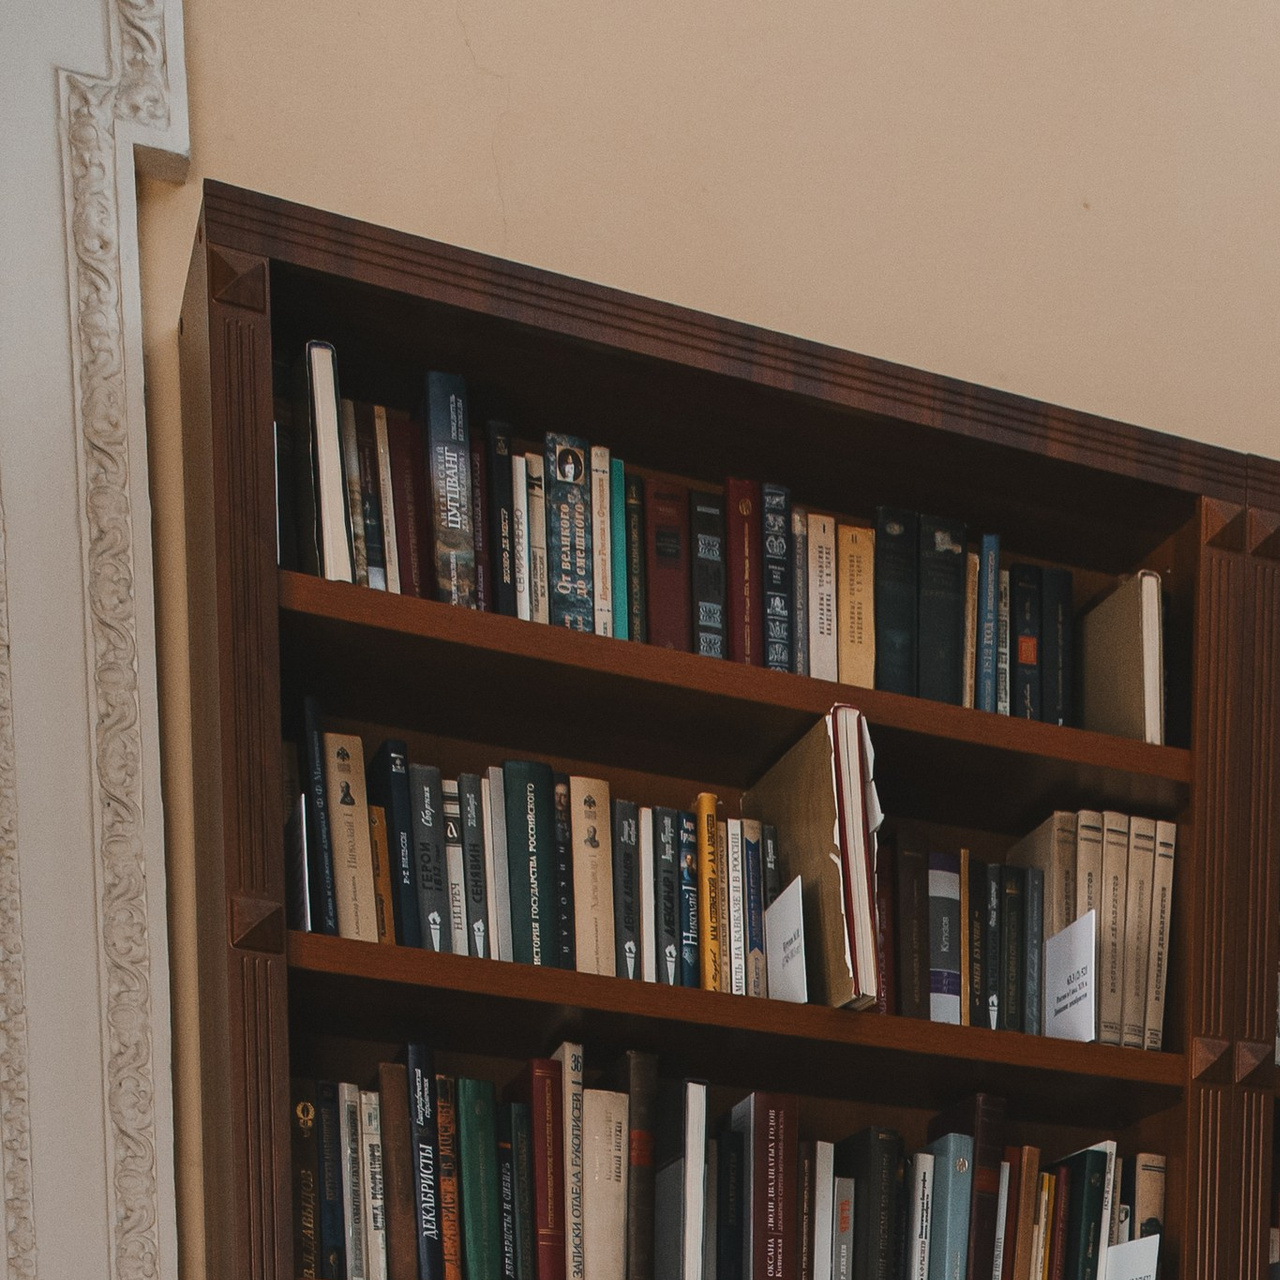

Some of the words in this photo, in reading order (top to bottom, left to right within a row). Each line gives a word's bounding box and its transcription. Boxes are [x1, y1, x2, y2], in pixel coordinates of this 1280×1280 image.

[445, 446, 461, 530] ЦУГЦВАНГ
[559, 503, 570, 570] великого
[573, 502, 585, 576] смешного
[557, 574, 571, 594] От
[575, 580, 588, 598] до
[983, 620, 994, 646] ГОД
[983, 647, 993, 675] 1812
[421, 785, 433, 828] Сборник
[526, 782, 537, 853] РОССИЙСКОГО
[344, 818, 357, 870] Николай
[420, 842, 433, 891] ГЕРОИ
[730, 832, 739, 872] РОССИИ
[468, 843, 484, 904] СЕНЯВИН
[528, 856, 540, 919] ГОСУДАРСТВА
[662, 876, 675, 939] АЛЕКСАНДР
[682, 892, 698, 946] Николай
[731, 895, 742, 942] КАВКАЗЕ
[1111, 874, 1120, 939] ДЕКАБРИСТОВ
[531, 922, 541, 965] ИСТОРИЯ
[1110, 940, 1119, 994] ВОССТАНИЕ
[415, 1068, 424, 1126] Биографический
[438, 1098, 454, 1157] МОСКВЕ
[569, 1092, 581, 1168] РУКОПИСЕЙ
[768, 1109, 776, 1140] ГОДОВ
[419, 1142, 438, 1240] ДЕКАБРИСТЫ
[501, 1162, 511, 1201] СИБИРЬ
[570, 1170, 581, 1219] ОТДЕЛА
[767, 1142, 776, 1199] ДВАДЦАТЫХ
[440, 1174, 457, 1266] ДЕКАБРИСТЫ
[767, 1200, 775, 1231] ЛЮДИ
[503, 1213, 514, 1278] ДЕКАБРИСТЫ
[571, 1221, 582, 1279] ЗАПИСКИ
[767, 1237, 775, 1278] ОКСАНА
[775, 1238, 784, 1278] Киянская
